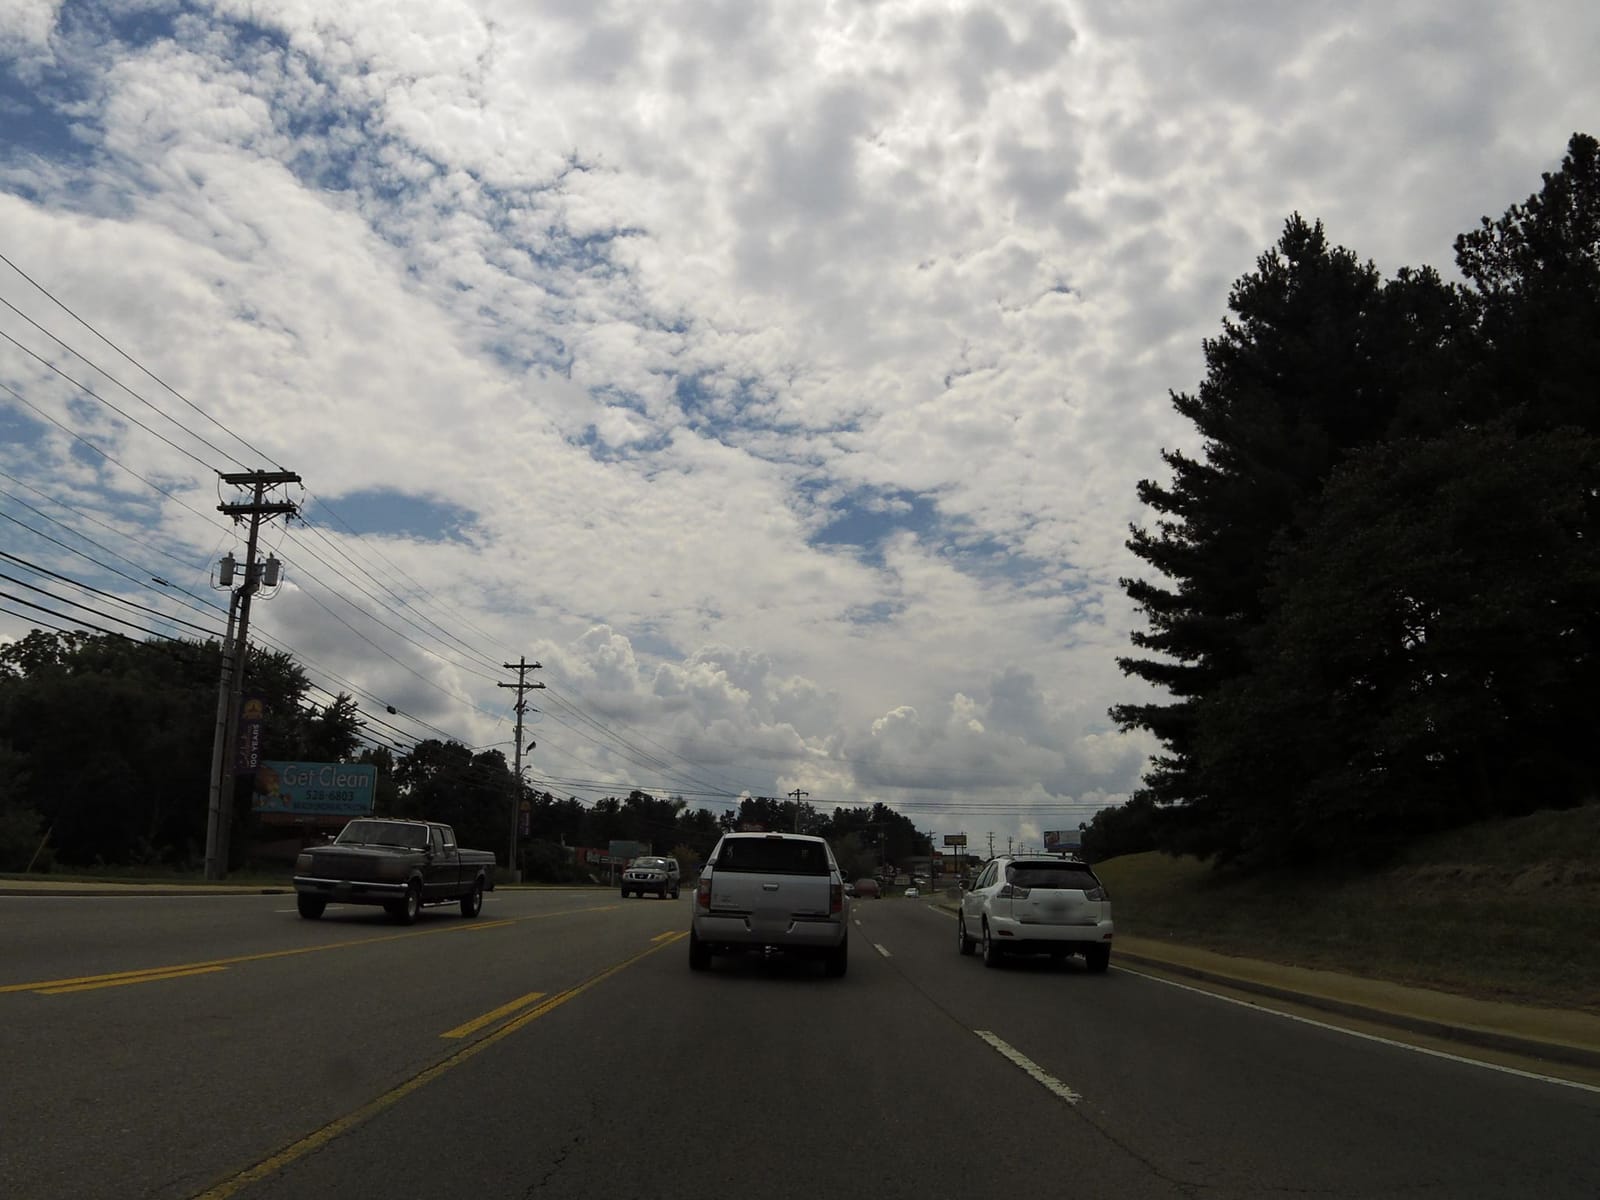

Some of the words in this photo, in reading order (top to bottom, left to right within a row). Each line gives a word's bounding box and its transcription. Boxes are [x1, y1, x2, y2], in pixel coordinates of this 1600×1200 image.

[251, 724, 260, 751] YEARS
[250, 754, 258, 768] 100
[283, 765, 316, 786] Get
[319, 766, 369, 788] Clean
